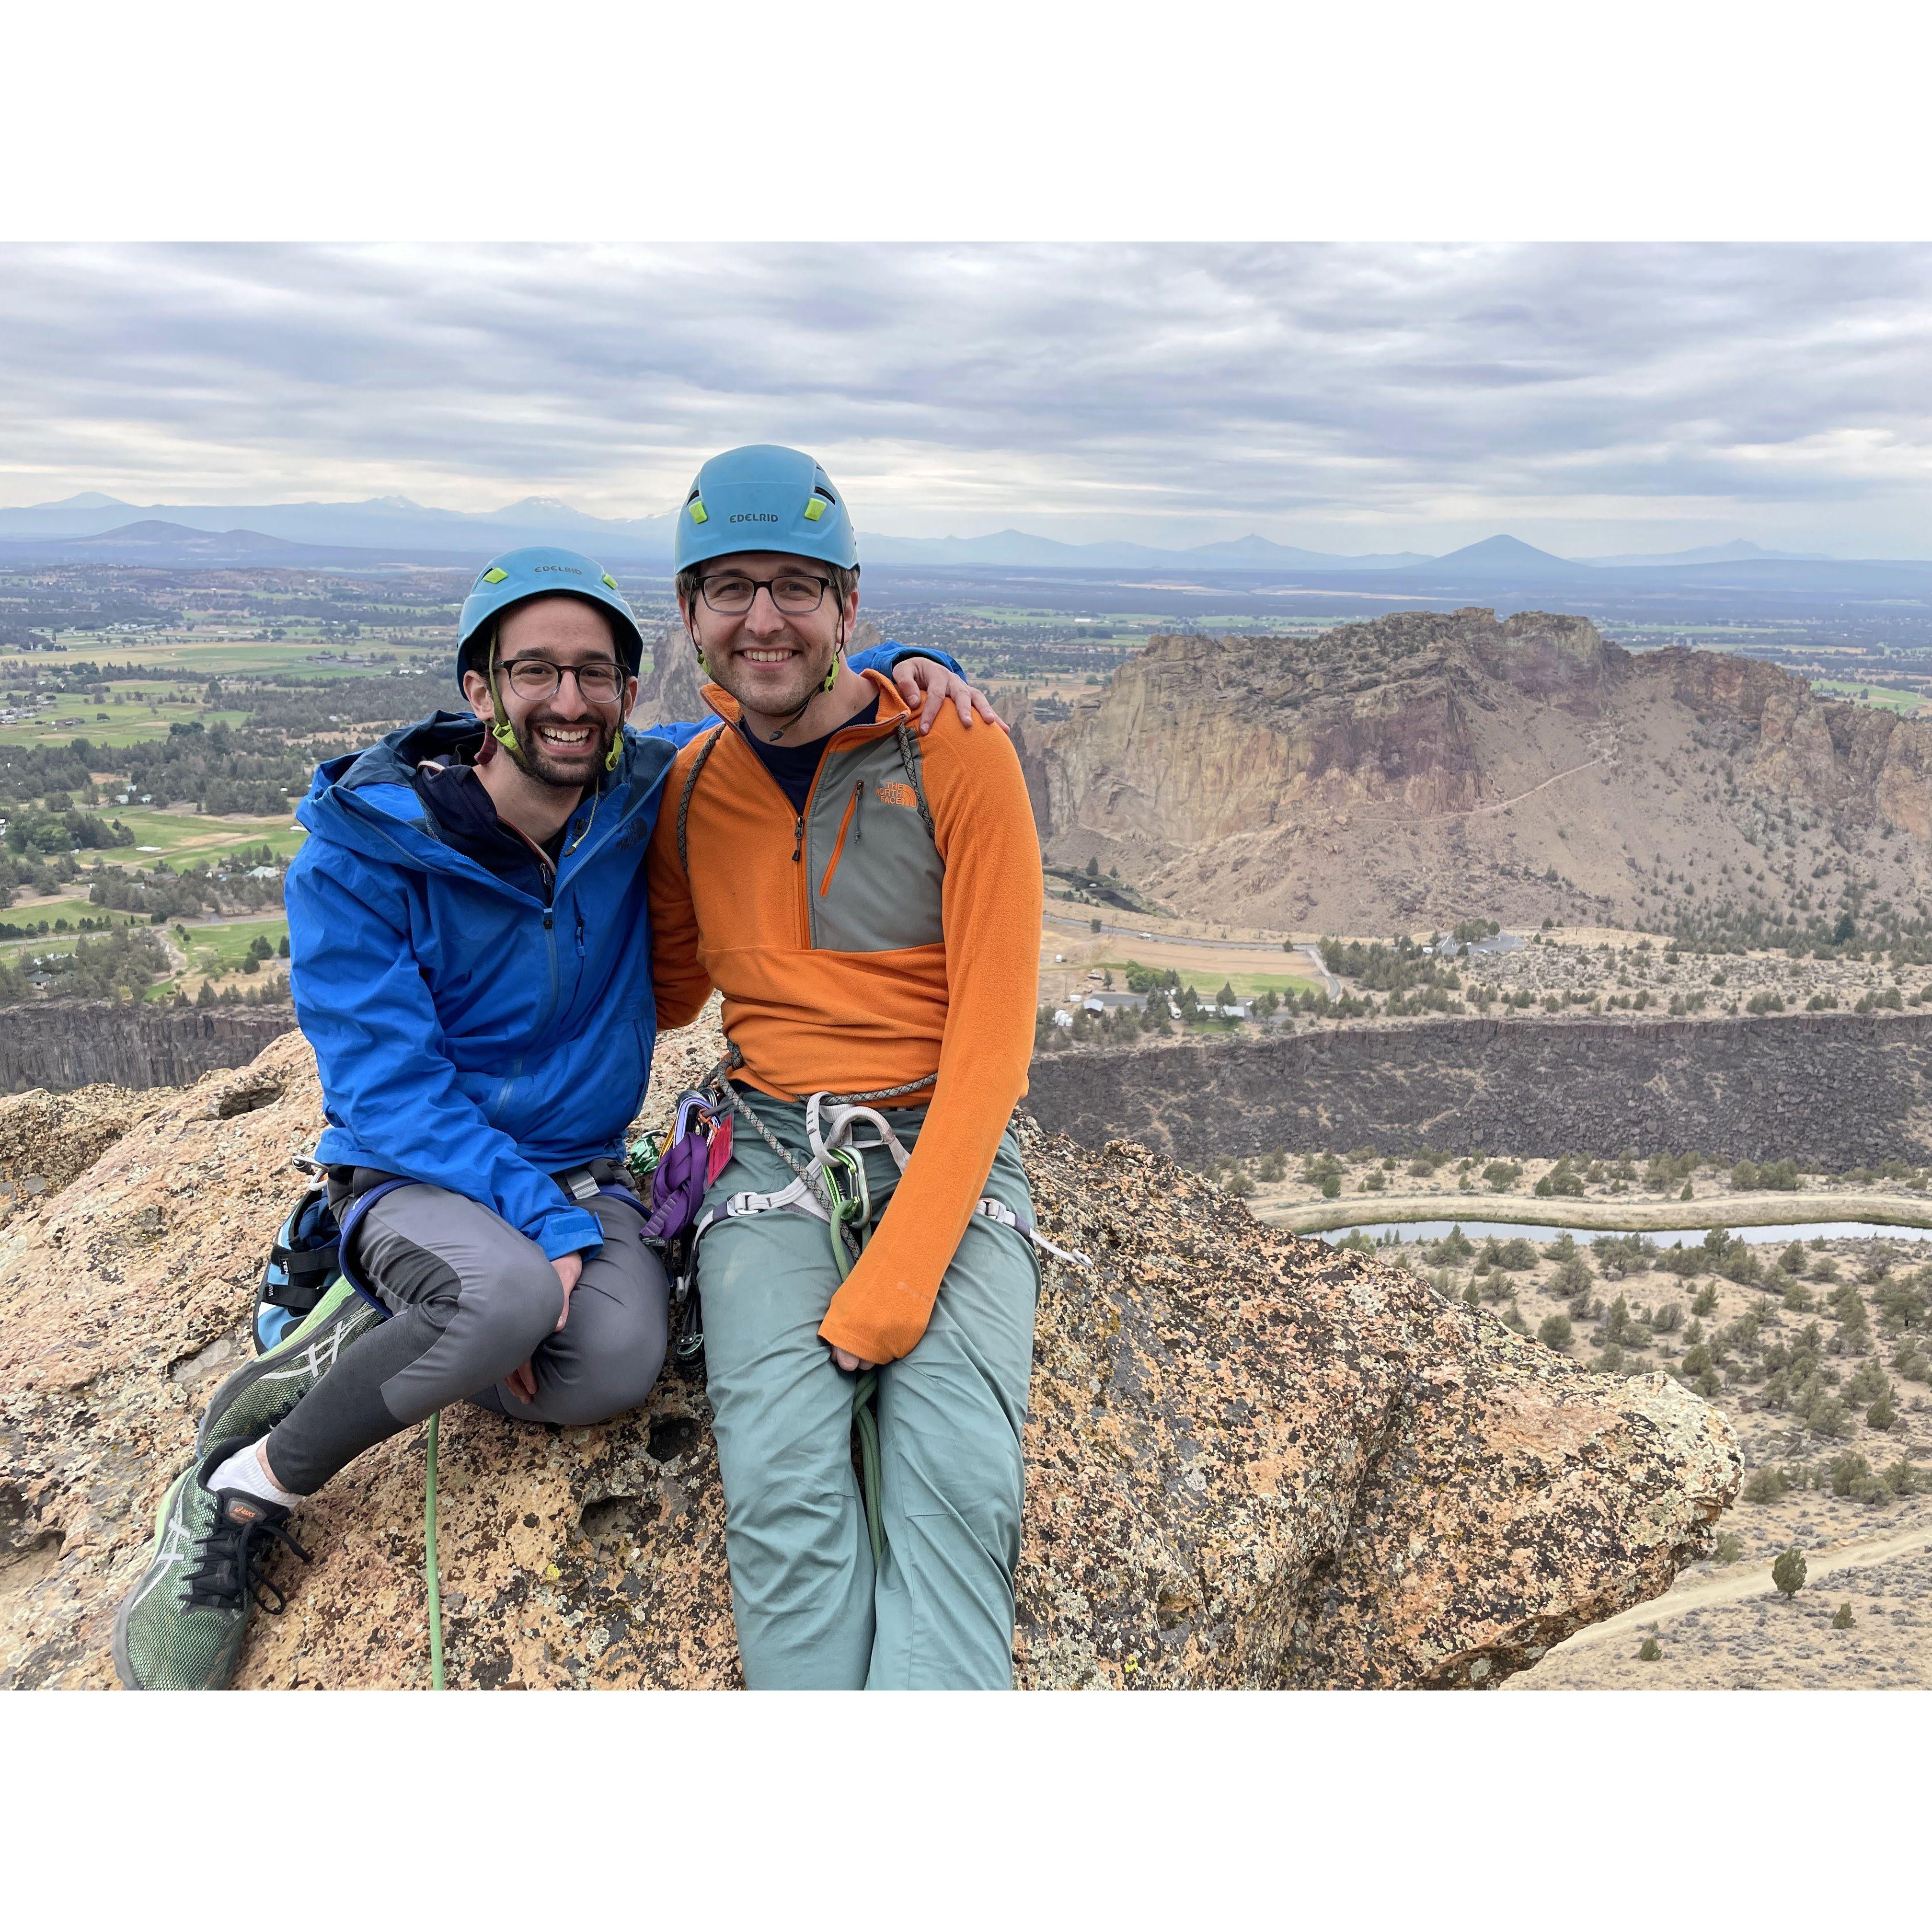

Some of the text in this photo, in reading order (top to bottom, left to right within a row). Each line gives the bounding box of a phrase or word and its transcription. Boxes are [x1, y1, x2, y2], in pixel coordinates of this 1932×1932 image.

[729, 513, 779, 523] EDELRID
[534, 565, 582, 575] EDELRID
[886, 782, 904, 790] THE
[875, 788, 902, 798] NORTH
[880, 796, 902, 805] FACE
